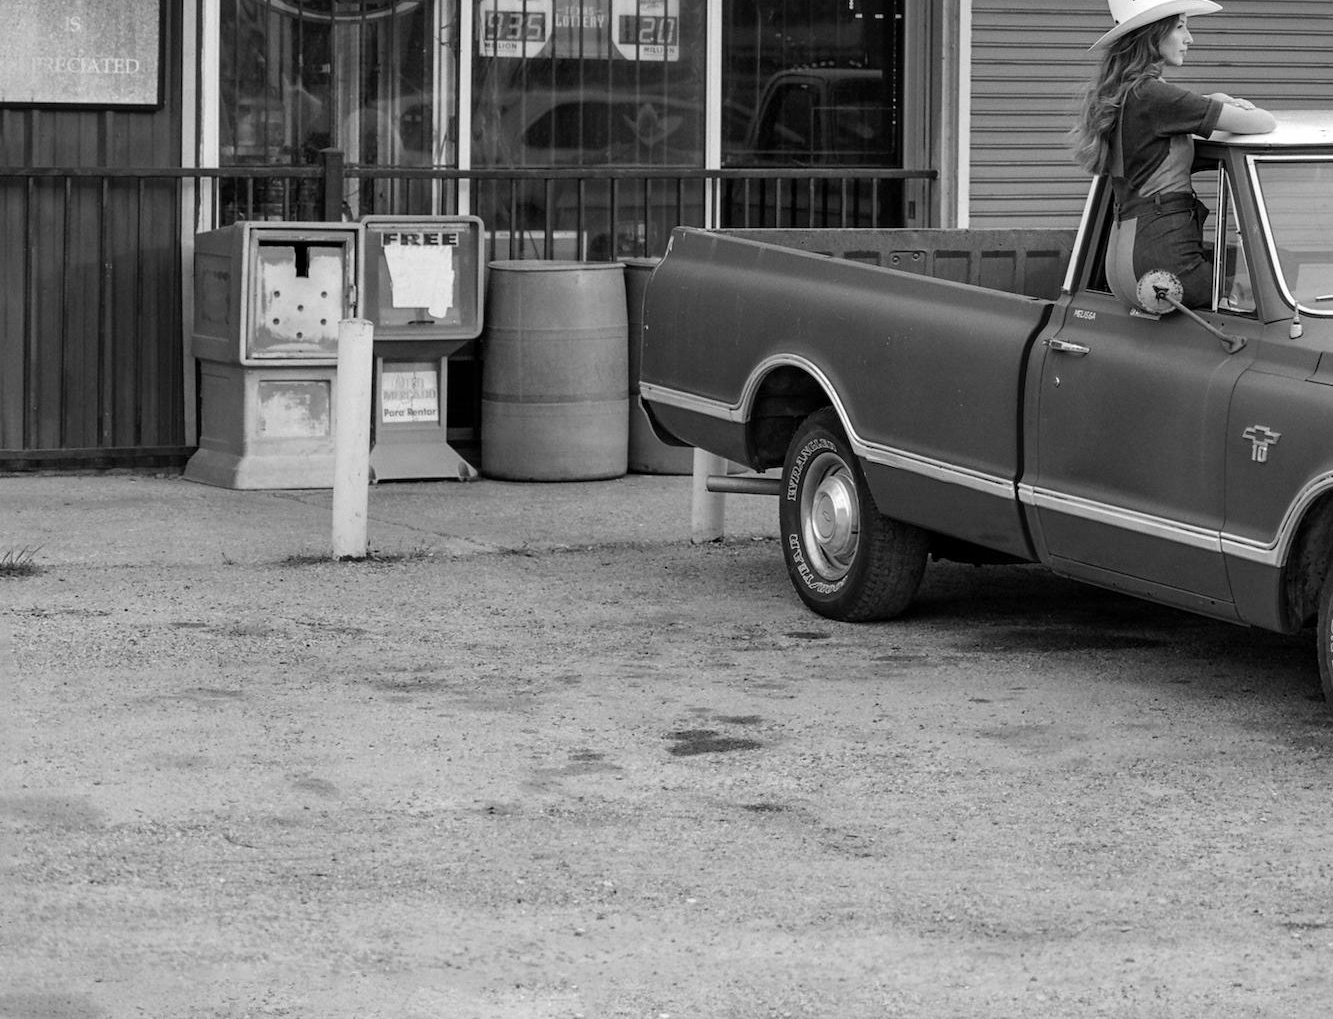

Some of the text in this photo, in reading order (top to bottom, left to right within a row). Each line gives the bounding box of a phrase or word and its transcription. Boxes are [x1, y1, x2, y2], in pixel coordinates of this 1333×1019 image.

[65, 15, 82, 33] IS
[555, 13, 605, 29] LOTTERY
[383, 233, 457, 246] FREE
[1251, 442, 1268, 463] 10
